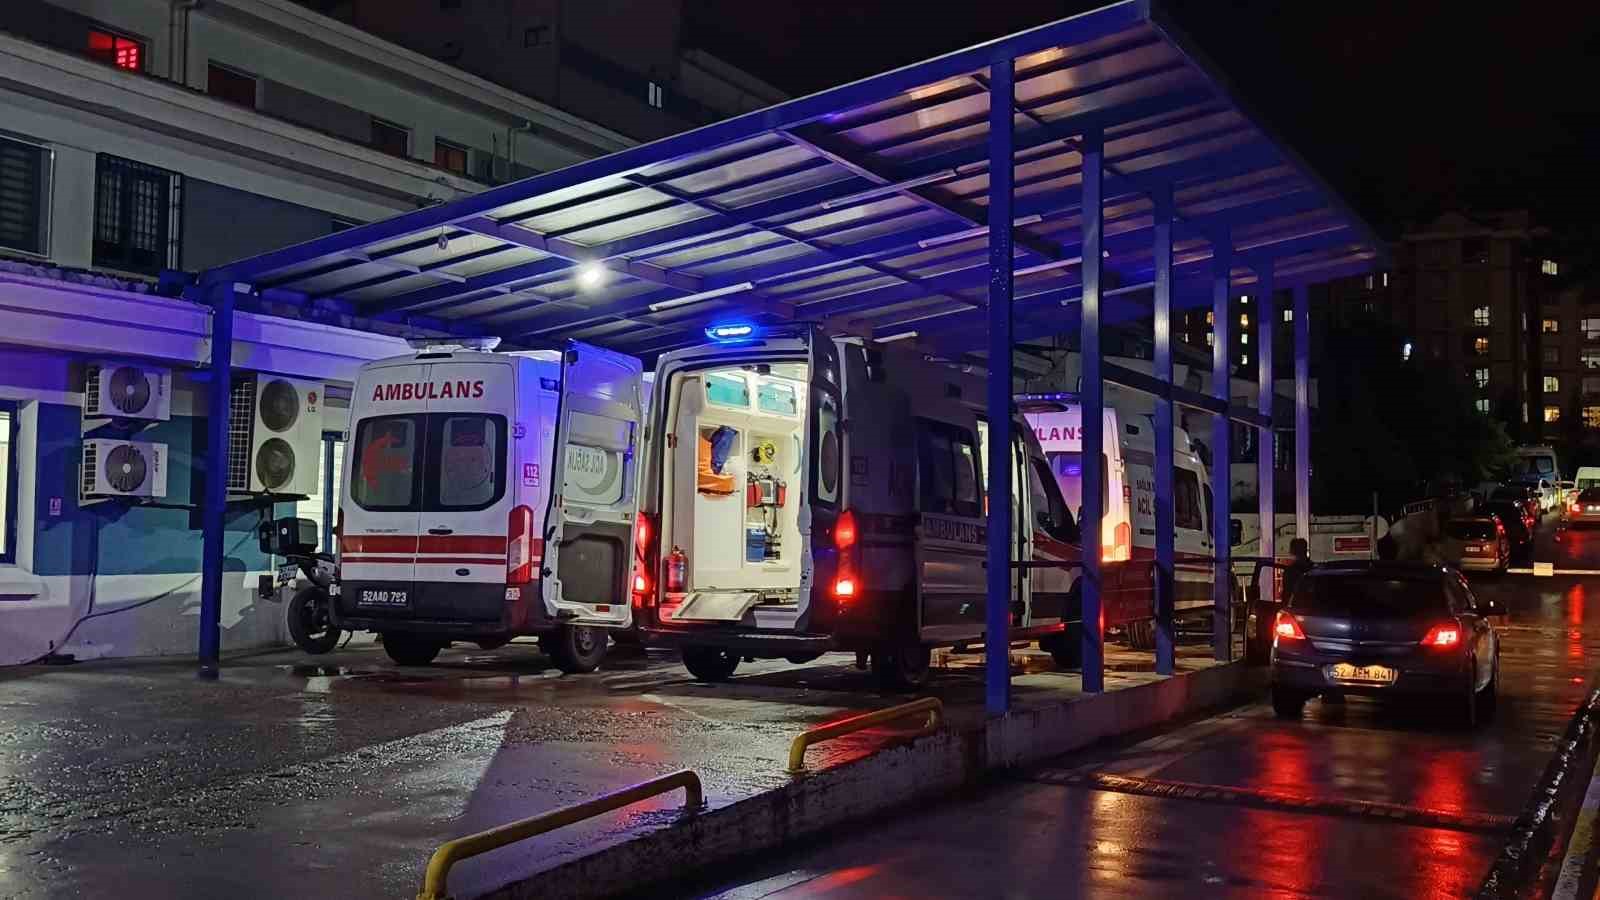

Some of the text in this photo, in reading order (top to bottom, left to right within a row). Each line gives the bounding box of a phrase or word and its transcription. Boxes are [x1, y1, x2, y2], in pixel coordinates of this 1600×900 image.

[372, 380, 485, 402] AMBULANS
[526, 465, 538, 477] 112
[925, 517, 977, 543] AMBULANS
